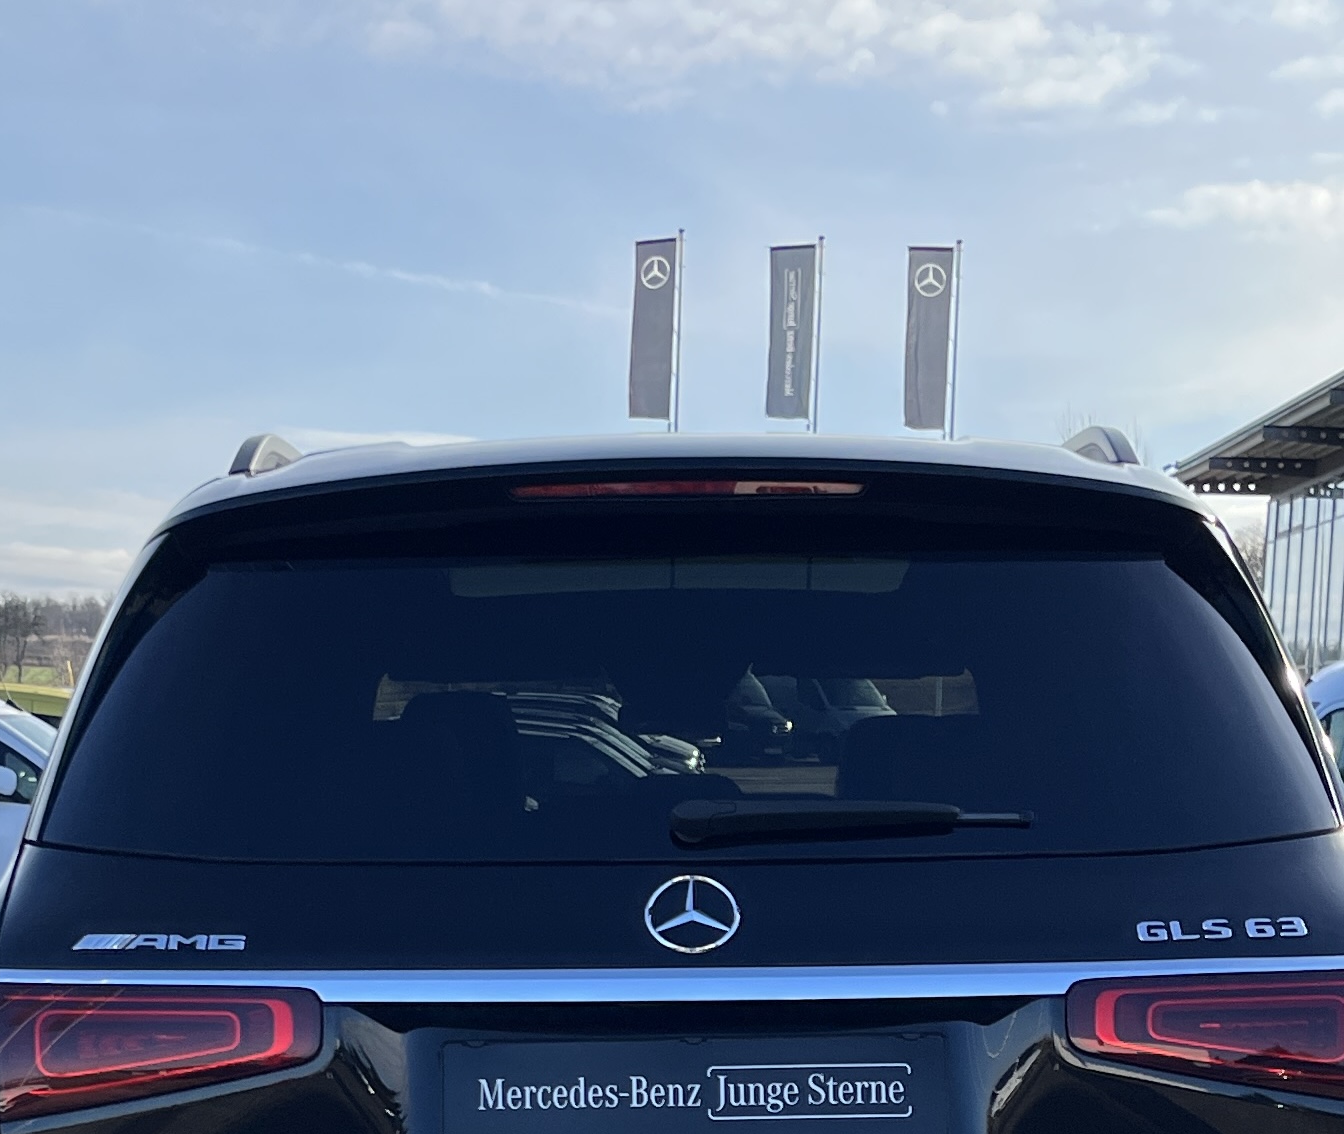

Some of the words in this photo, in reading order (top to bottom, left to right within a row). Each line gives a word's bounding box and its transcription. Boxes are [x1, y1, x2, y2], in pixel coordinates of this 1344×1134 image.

[124, 934, 247, 950] AMG
[1136, 919, 1233, 942] GLS
[1244, 916, 1308, 938] 63
[478, 1075, 702, 1111] Mercedes-Benz
[716, 1074, 800, 1113] Junge
[808, 1073, 905, 1105] Sterne
